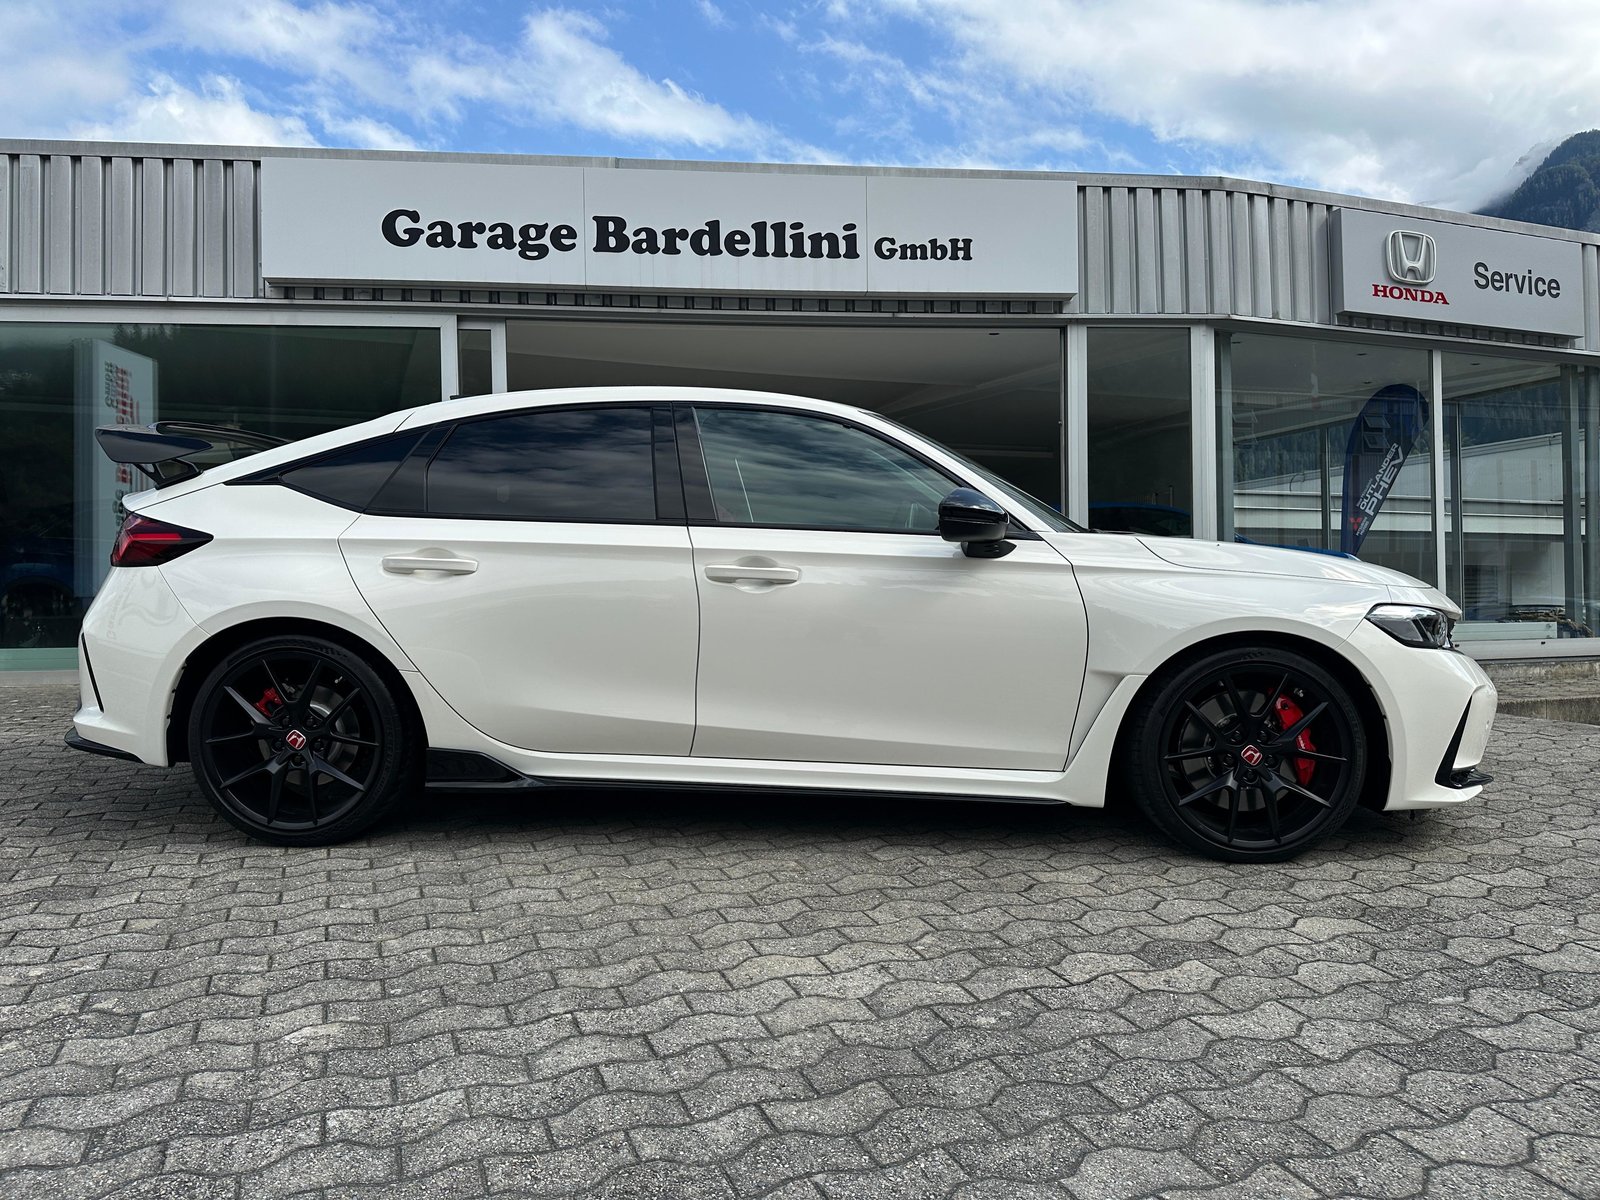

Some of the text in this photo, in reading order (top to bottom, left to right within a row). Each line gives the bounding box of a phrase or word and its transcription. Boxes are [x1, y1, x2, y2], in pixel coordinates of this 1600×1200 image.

[381, 209, 973, 261] Garage Bardellini GmbH
[1372, 284, 1450, 305] HONDA
[1473, 261, 1561, 299] Service
[1360, 442, 1399, 510] OUTLANDER
[1365, 446, 1404, 516] PHEV
